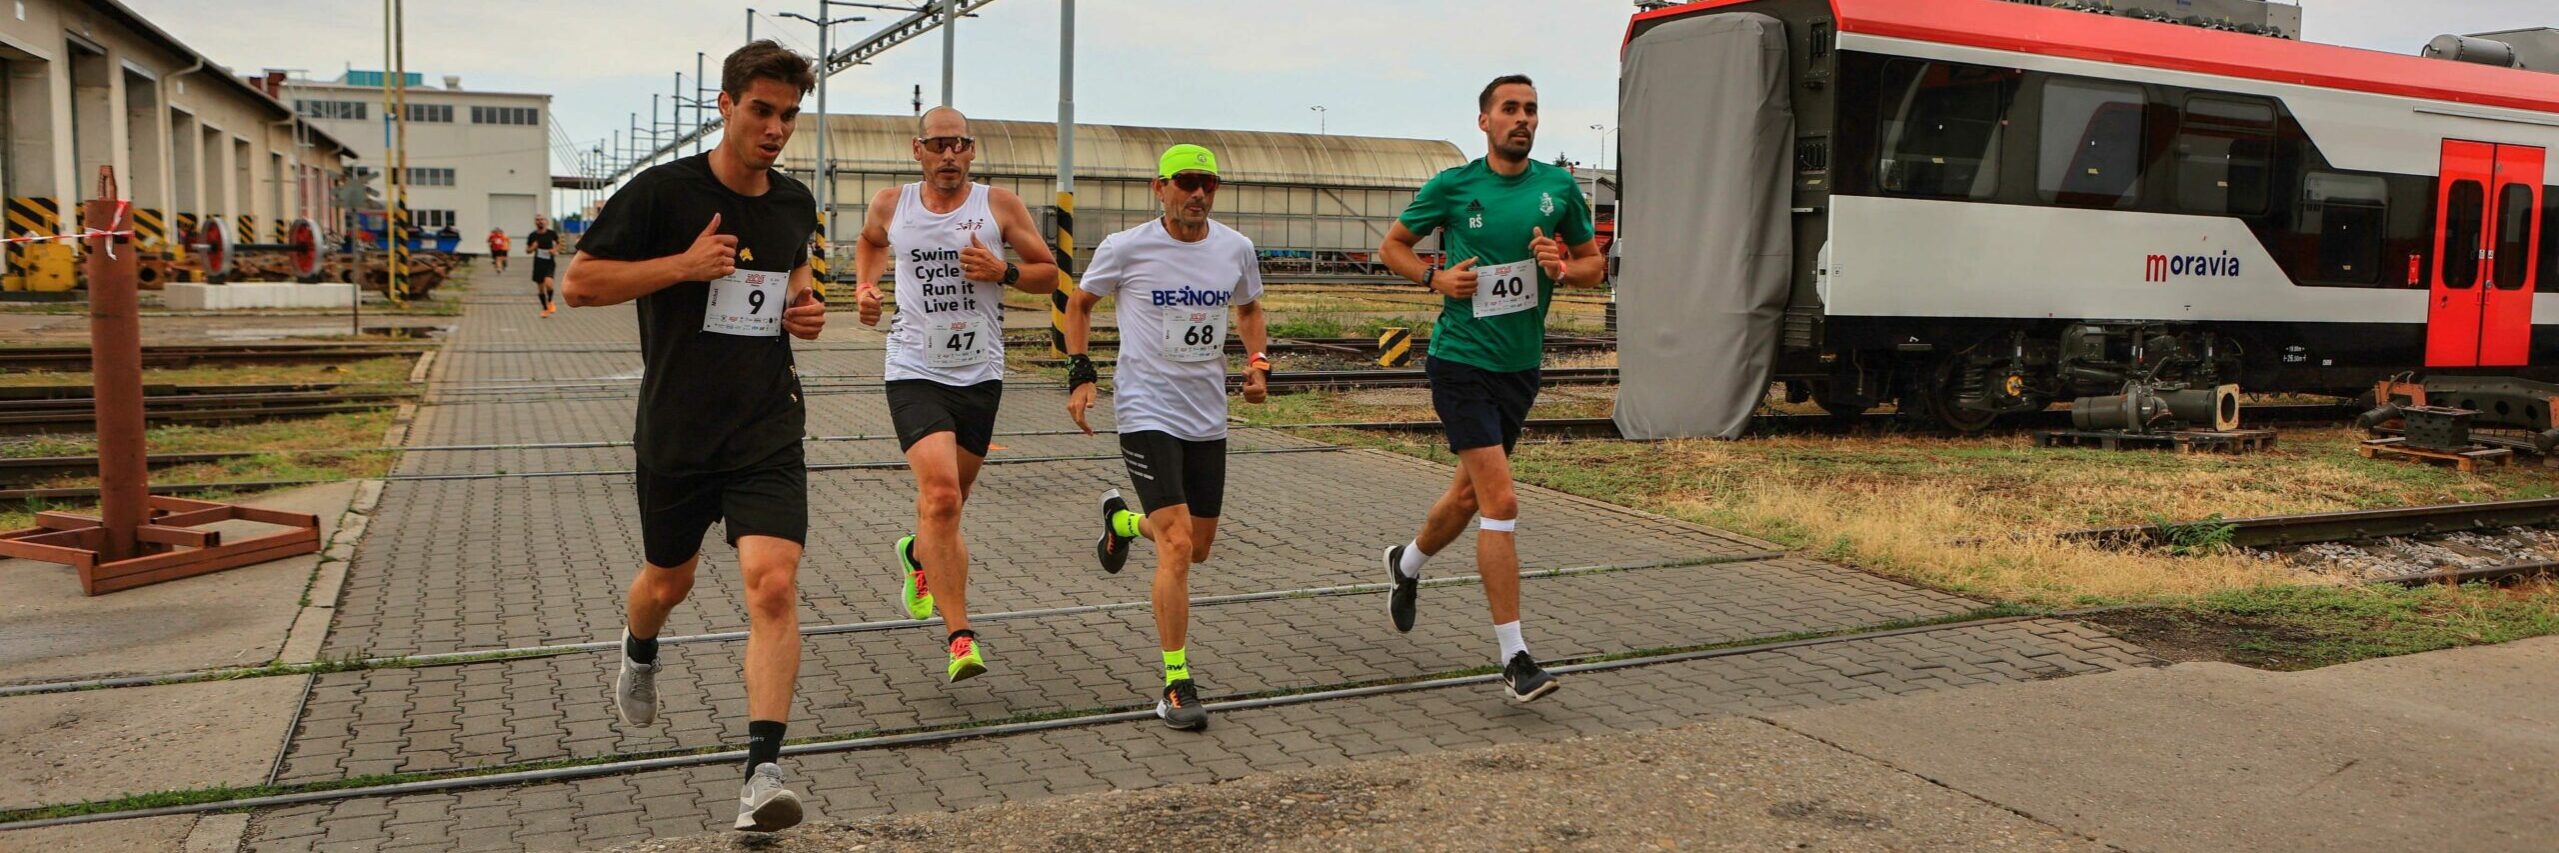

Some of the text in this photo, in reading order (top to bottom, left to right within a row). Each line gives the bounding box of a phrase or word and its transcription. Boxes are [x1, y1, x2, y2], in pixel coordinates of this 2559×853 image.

[1469, 214, 1483, 228] RŠ
[911, 247, 959, 262] Swim
[915, 264, 960, 282] Cycle
[2145, 250, 2239, 282] moravia
[923, 281, 975, 297] Run it
[1491, 277, 1522, 297] 40
[748, 289, 765, 315] 9
[924, 298, 976, 314] Live it
[946, 331, 976, 352] 47
[1184, 325, 1213, 345] 68
